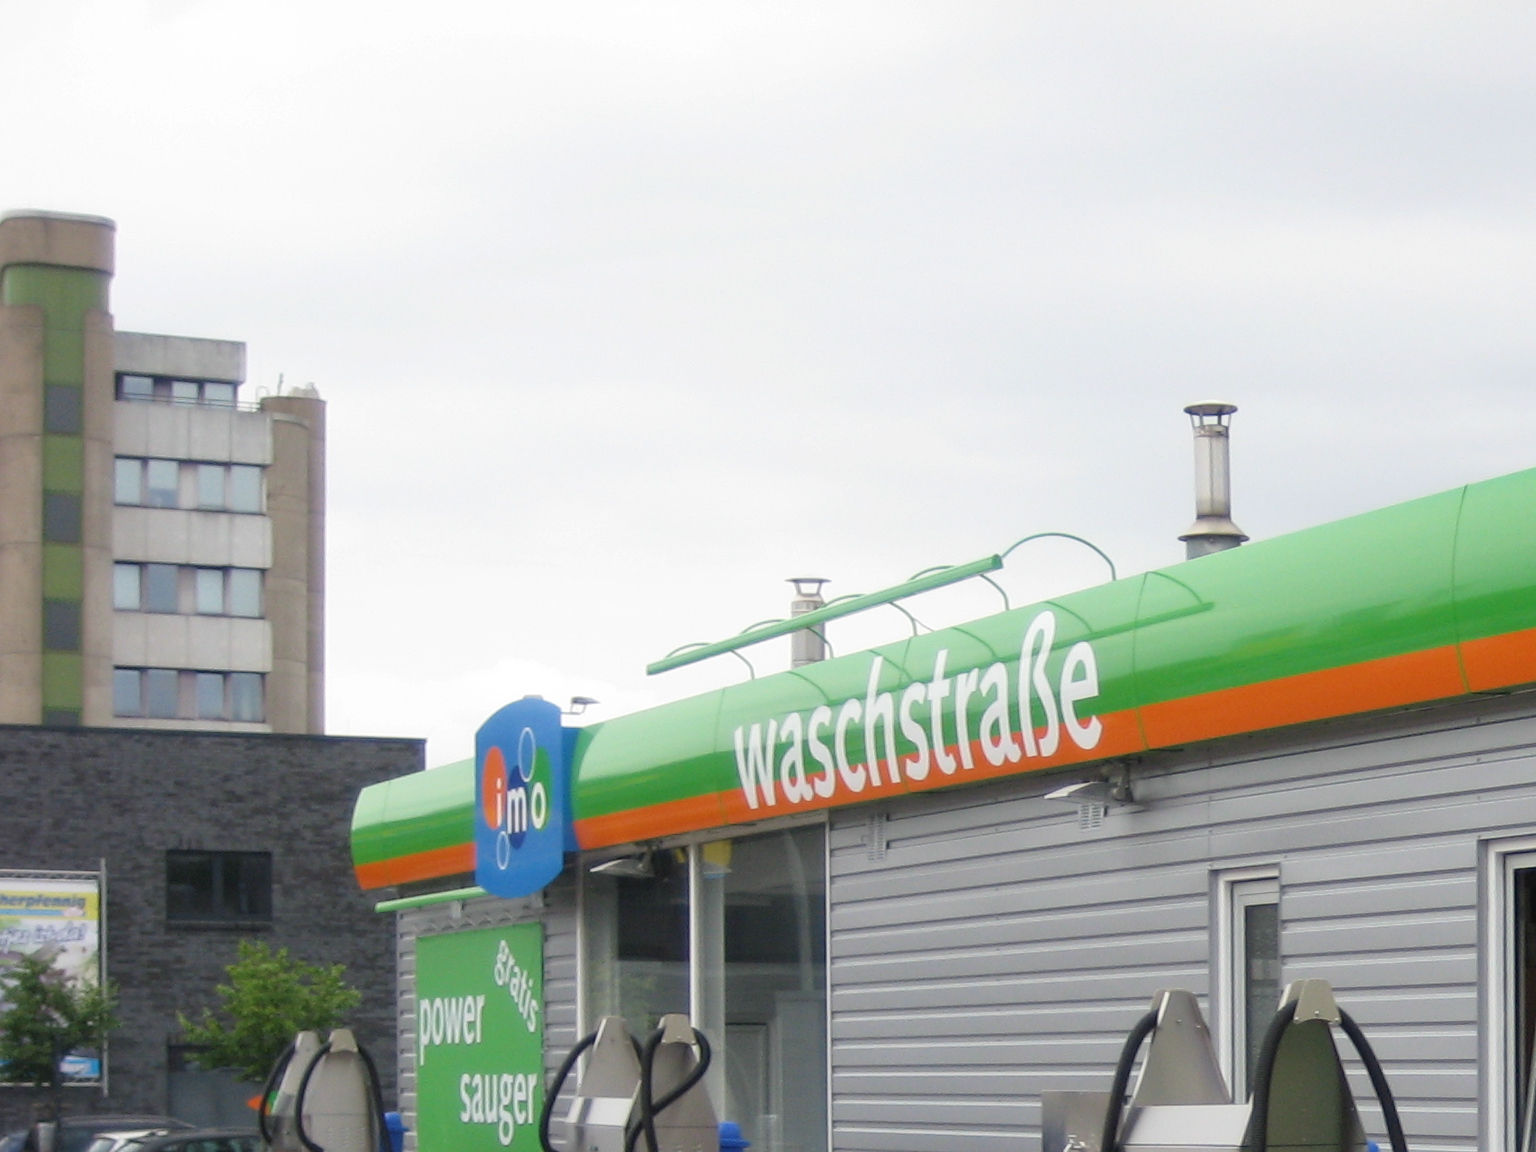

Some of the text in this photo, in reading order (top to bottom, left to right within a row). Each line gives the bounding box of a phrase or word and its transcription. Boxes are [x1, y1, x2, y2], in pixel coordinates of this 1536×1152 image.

[733, 609, 1102, 810] waschstraße
[495, 776, 547, 835] imo
[494, 939, 539, 1033] gratis
[419, 993, 486, 1067] power
[459, 1072, 538, 1146] sauger
